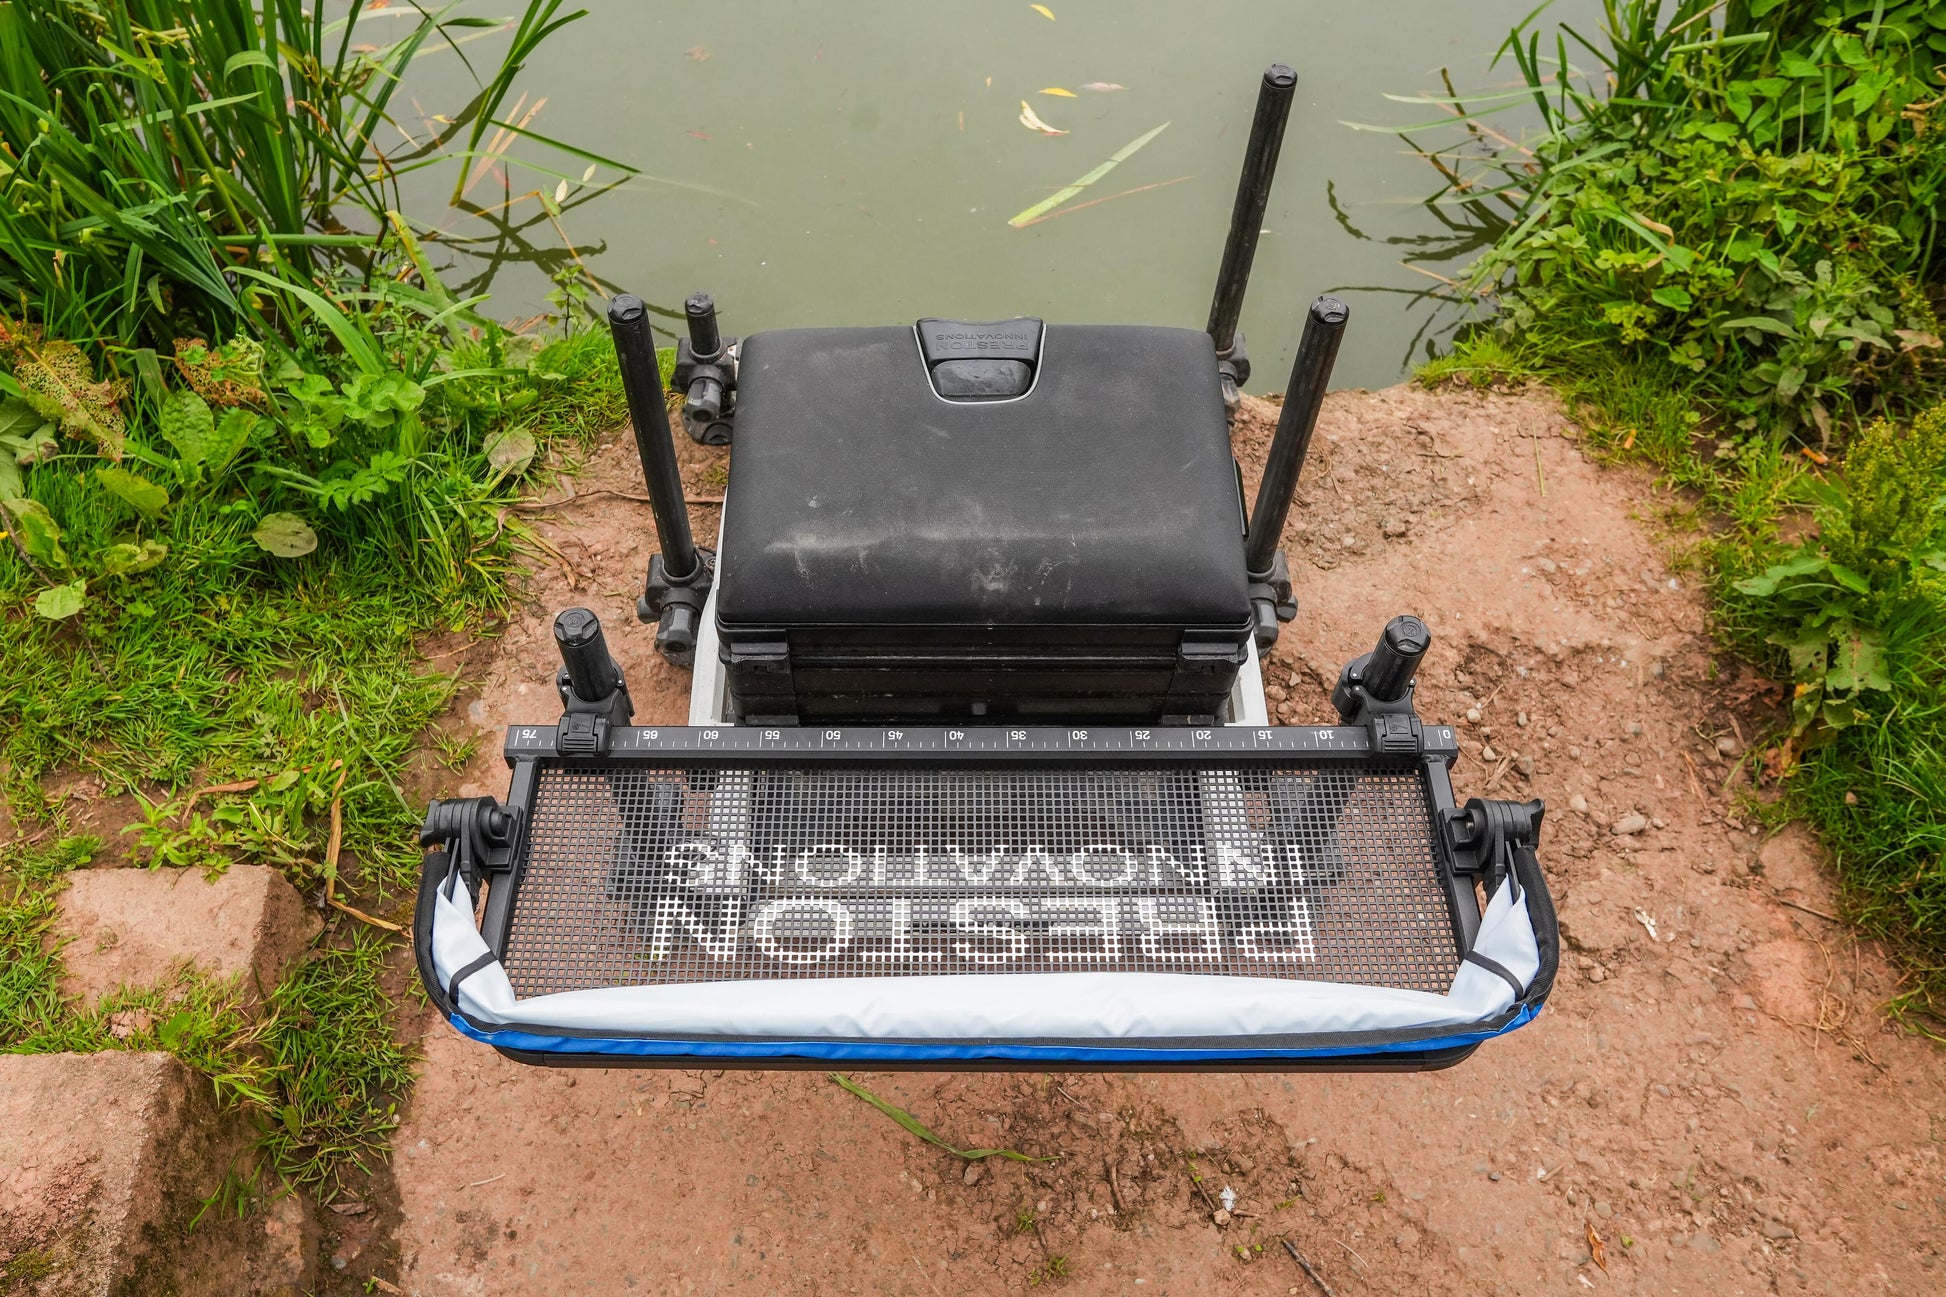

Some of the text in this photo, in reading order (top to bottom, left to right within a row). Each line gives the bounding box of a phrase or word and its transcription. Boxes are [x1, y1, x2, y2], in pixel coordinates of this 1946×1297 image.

[935, 333, 1028, 341] INNOVATIONS
[936, 340, 1029, 351] PRESTON
[522, 729, 1452, 741] 0 10 15 20 25 30 35 40 45 50 55 60 65 75
[664, 843, 1303, 886] INNOVATIONS
[651, 894, 1316, 964] PRESTON
